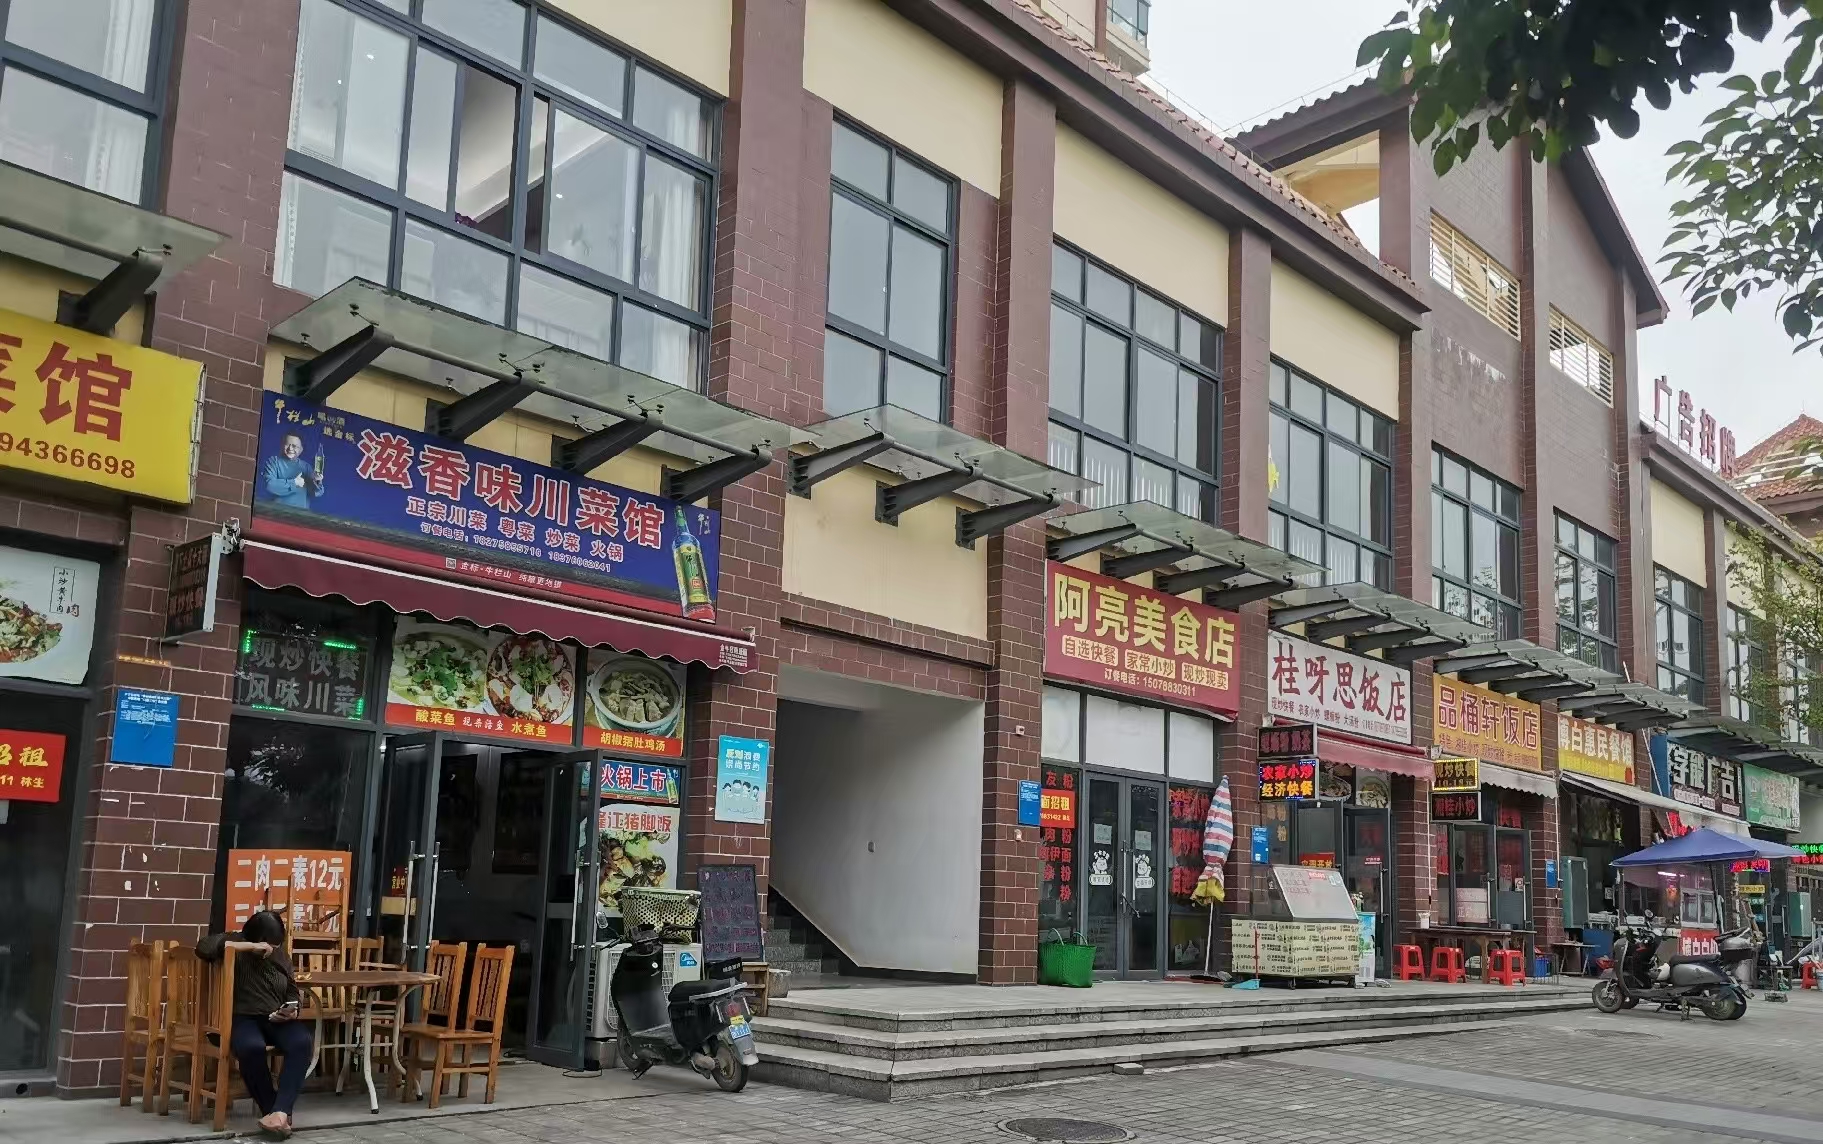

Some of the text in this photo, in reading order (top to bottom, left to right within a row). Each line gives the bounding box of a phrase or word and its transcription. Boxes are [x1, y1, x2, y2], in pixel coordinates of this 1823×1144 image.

[0, 333, 132, 442] 馆
[356, 428, 665, 549] 滋香味川菜馆
[406, 496, 624, 562] 正宗川菜 粤菜 炒菜 火锅
[1054, 572, 1235, 668] 阿亮美食店
[1064, 636, 1228, 690] 自选快餐 家常小炒 现炒现卖
[1272, 640, 1407, 723] 桂呀思饭店
[245, 672, 357, 717] 风味川菜
[1438, 683, 1539, 750] 品桶轩饭店
[415, 708, 456, 727] 酸菜鱼
[511, 721, 547, 738] 水煮鱼
[600, 731, 666, 752] 胡椒猪肚鸡汤
[600, 763, 667, 793] 火锅上市
[1261, 780, 1314, 797] 经济快餐
[235, 854, 344, 891] 二肉二素12元
